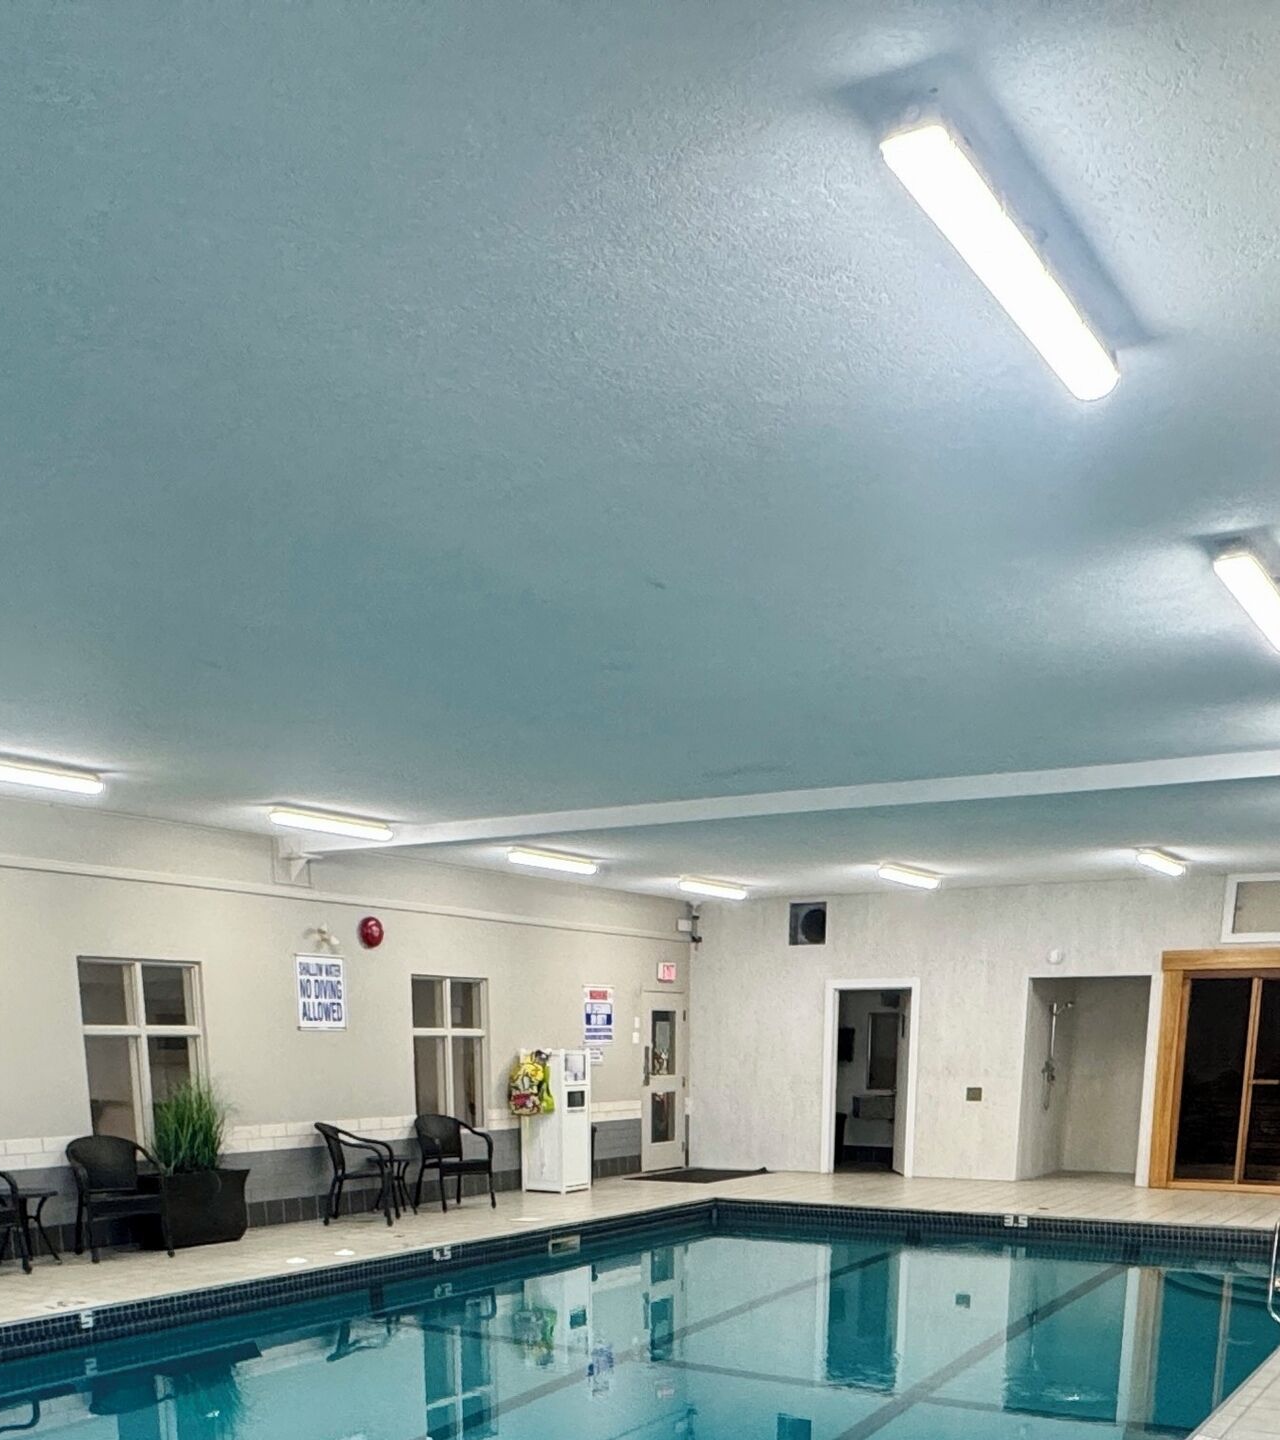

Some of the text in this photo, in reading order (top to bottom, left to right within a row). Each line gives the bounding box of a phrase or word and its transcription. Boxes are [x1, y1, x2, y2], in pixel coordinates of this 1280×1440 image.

[300, 979, 342, 999] NO DIVING
[302, 1001, 342, 1021] ALLOWED
[1003, 1215, 1028, 1228] 3.5
[81, 1310, 93, 1329] 5
